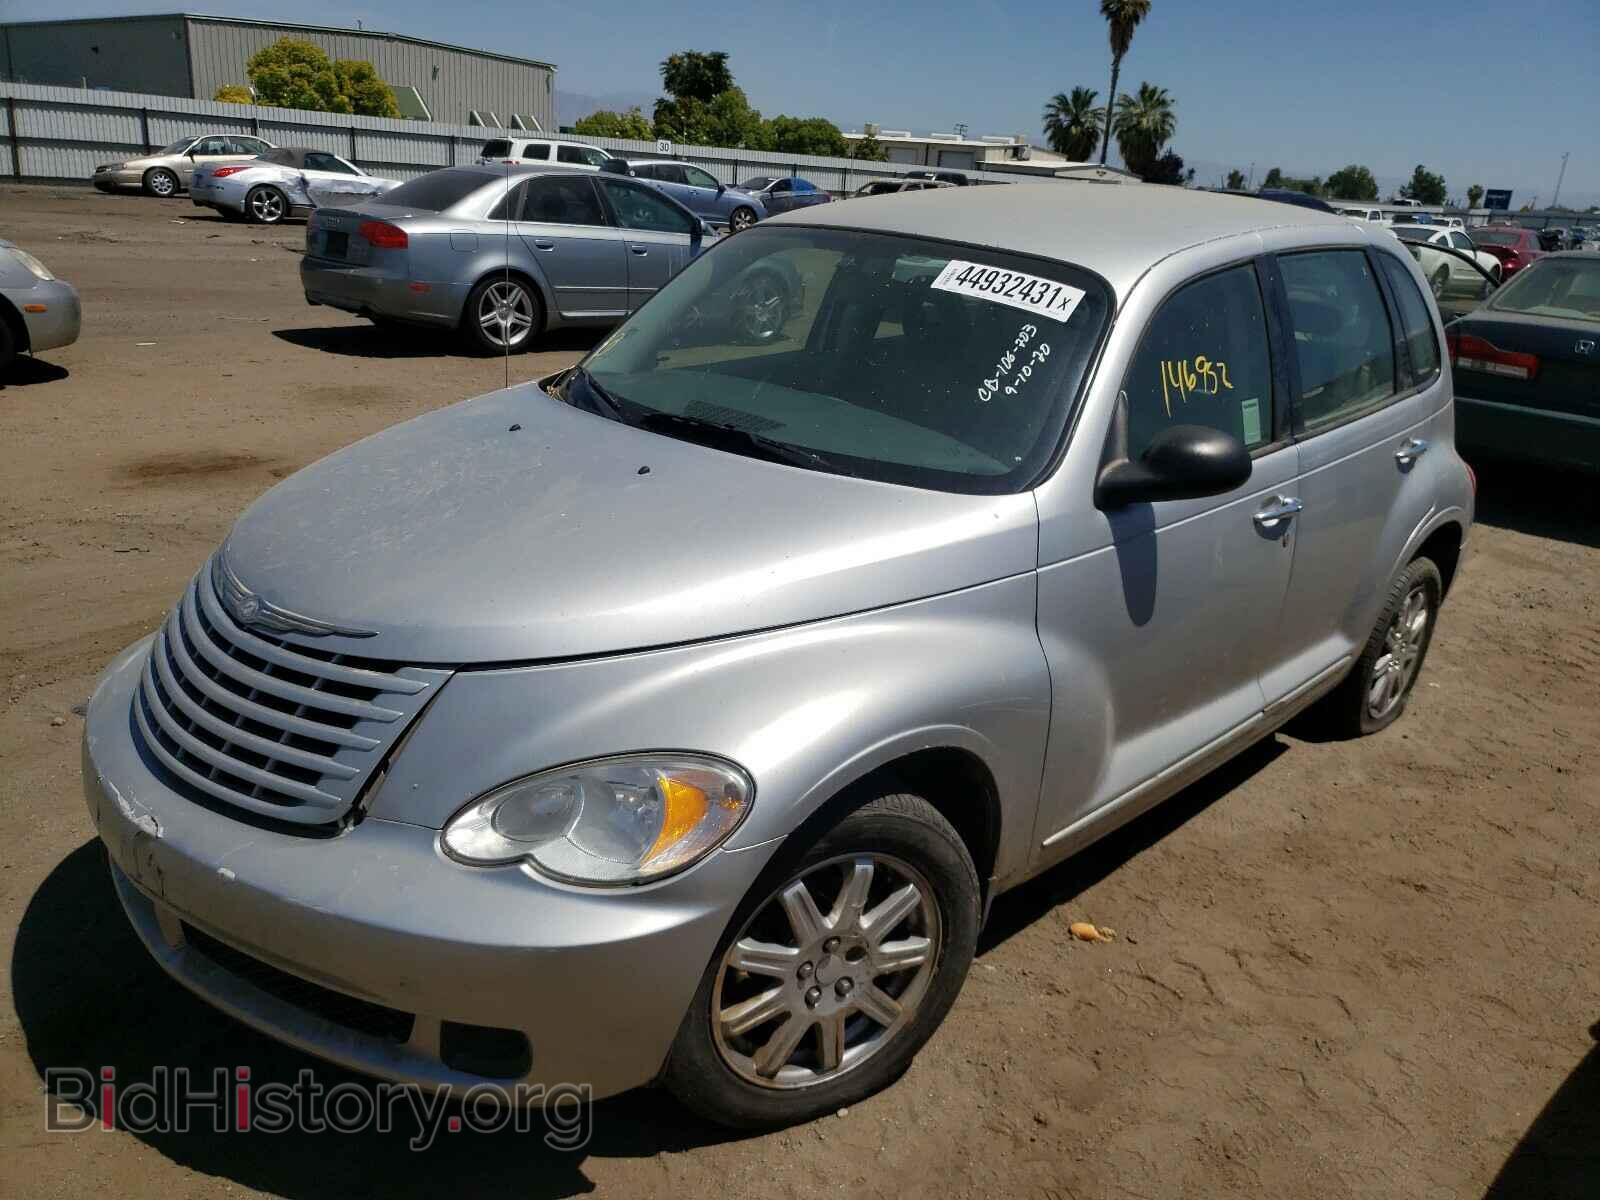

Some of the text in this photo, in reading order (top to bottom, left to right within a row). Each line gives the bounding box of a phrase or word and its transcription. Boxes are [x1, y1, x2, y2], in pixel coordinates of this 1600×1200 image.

[660, 143, 669, 152] 30
[955, 265, 1063, 308] 44932431
[1005, 343, 1051, 396] 9-10-20
